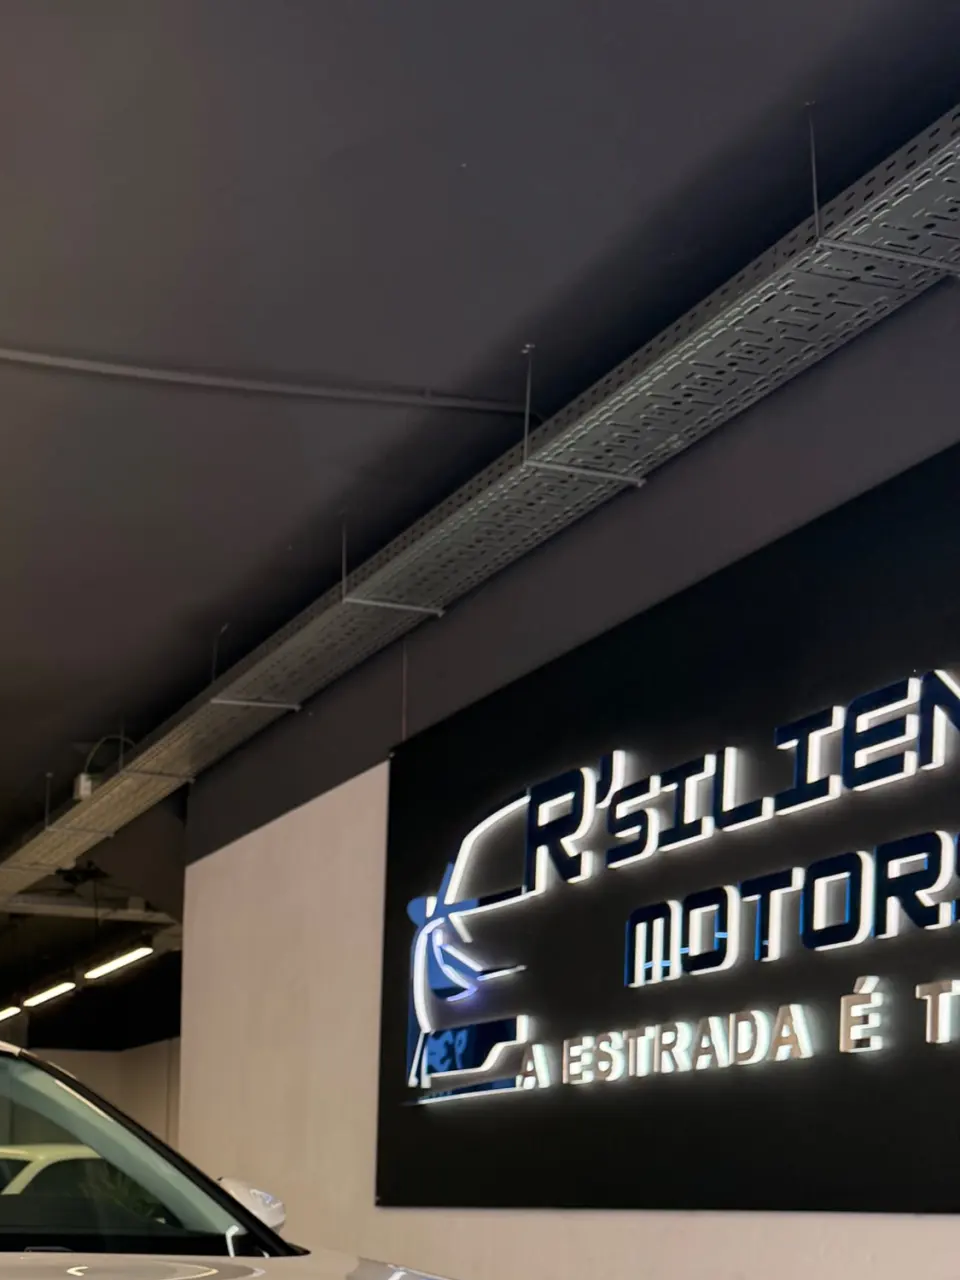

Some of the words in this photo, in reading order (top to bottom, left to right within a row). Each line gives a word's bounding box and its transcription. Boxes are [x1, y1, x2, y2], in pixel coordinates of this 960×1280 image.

[623, 829, 960, 988] MOTOR
[517, 1042, 551, 1089] A
[562, 1003, 814, 1085] ESTRADA
[839, 975, 883, 1053] É
